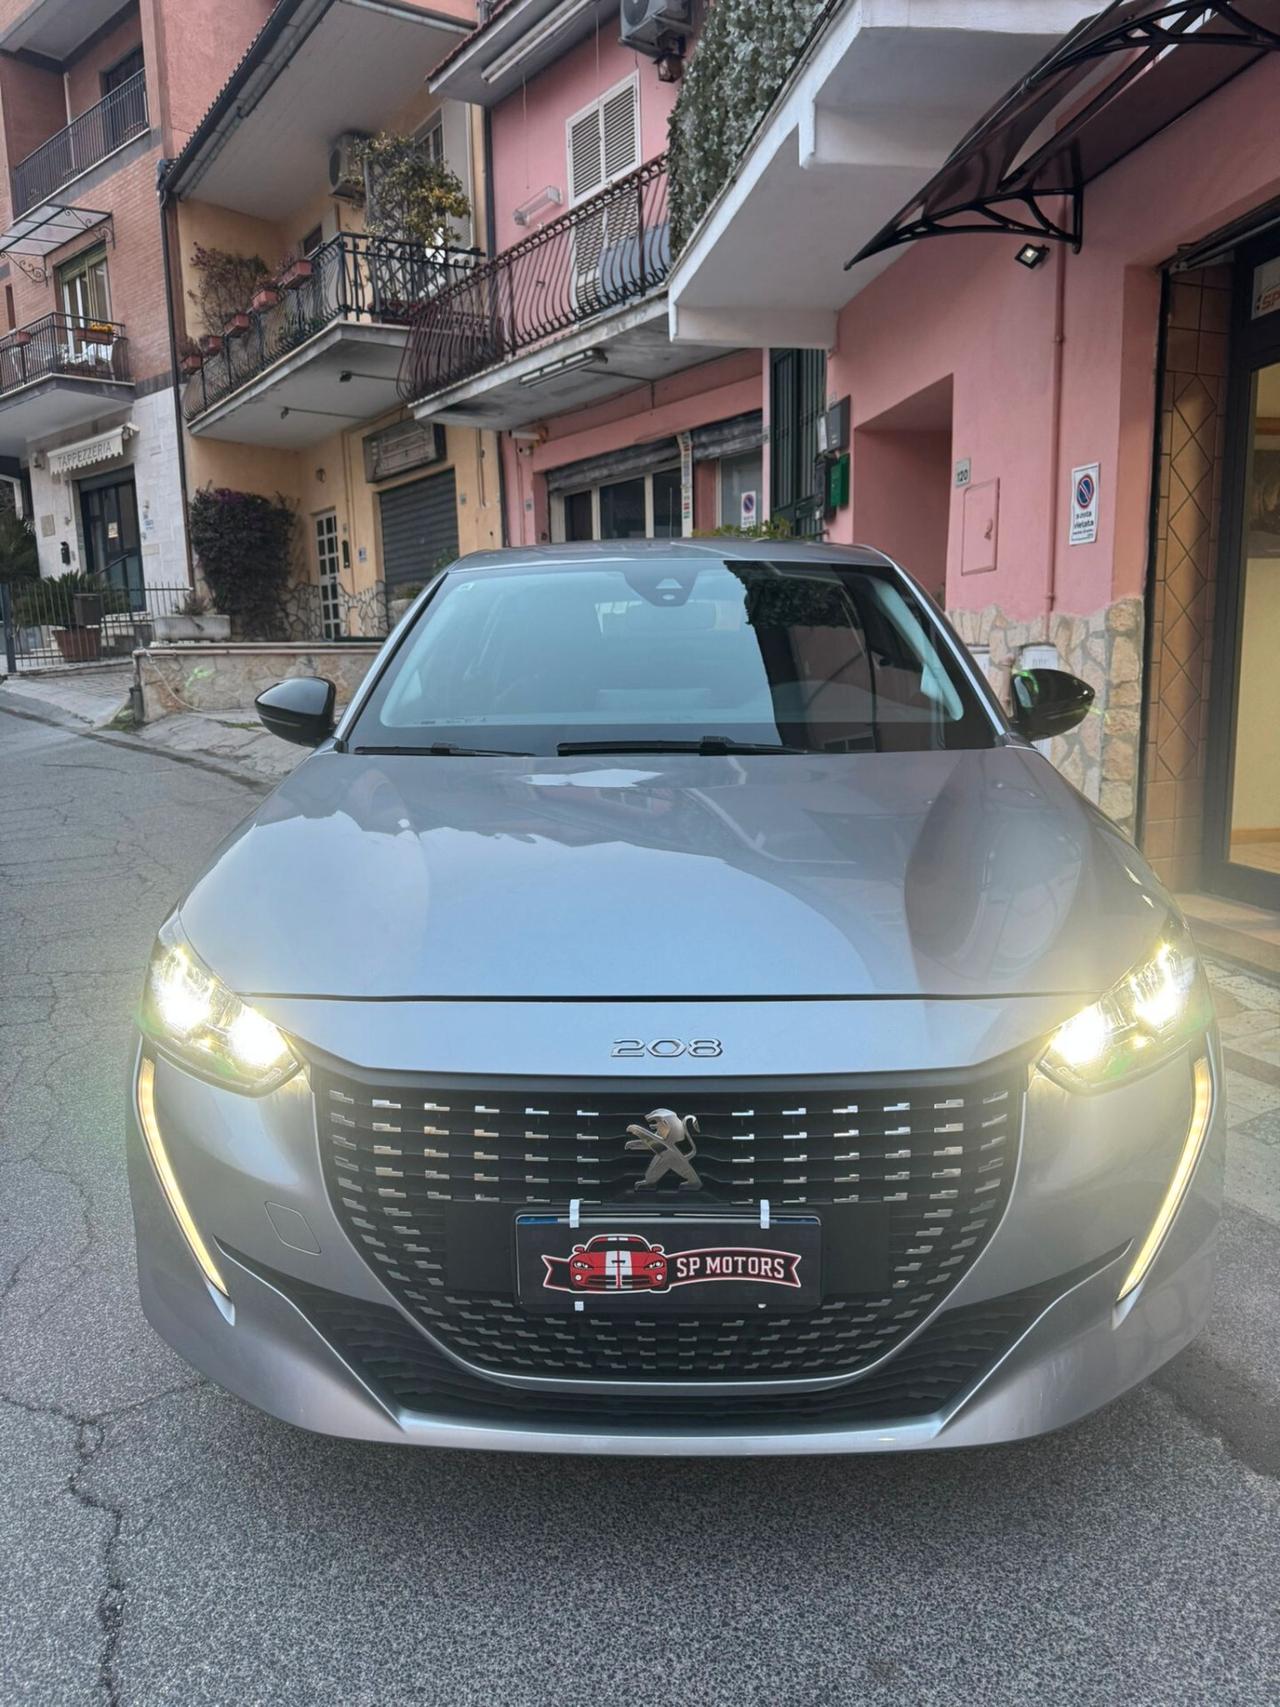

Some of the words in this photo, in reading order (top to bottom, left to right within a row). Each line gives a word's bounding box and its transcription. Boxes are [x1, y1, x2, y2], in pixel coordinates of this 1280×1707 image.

[57, 440, 112, 468] TAPPEZZERIA
[611, 1038, 723, 1058] 208
[676, 1257, 700, 1278] SP
[705, 1256, 785, 1279] MOTORS
